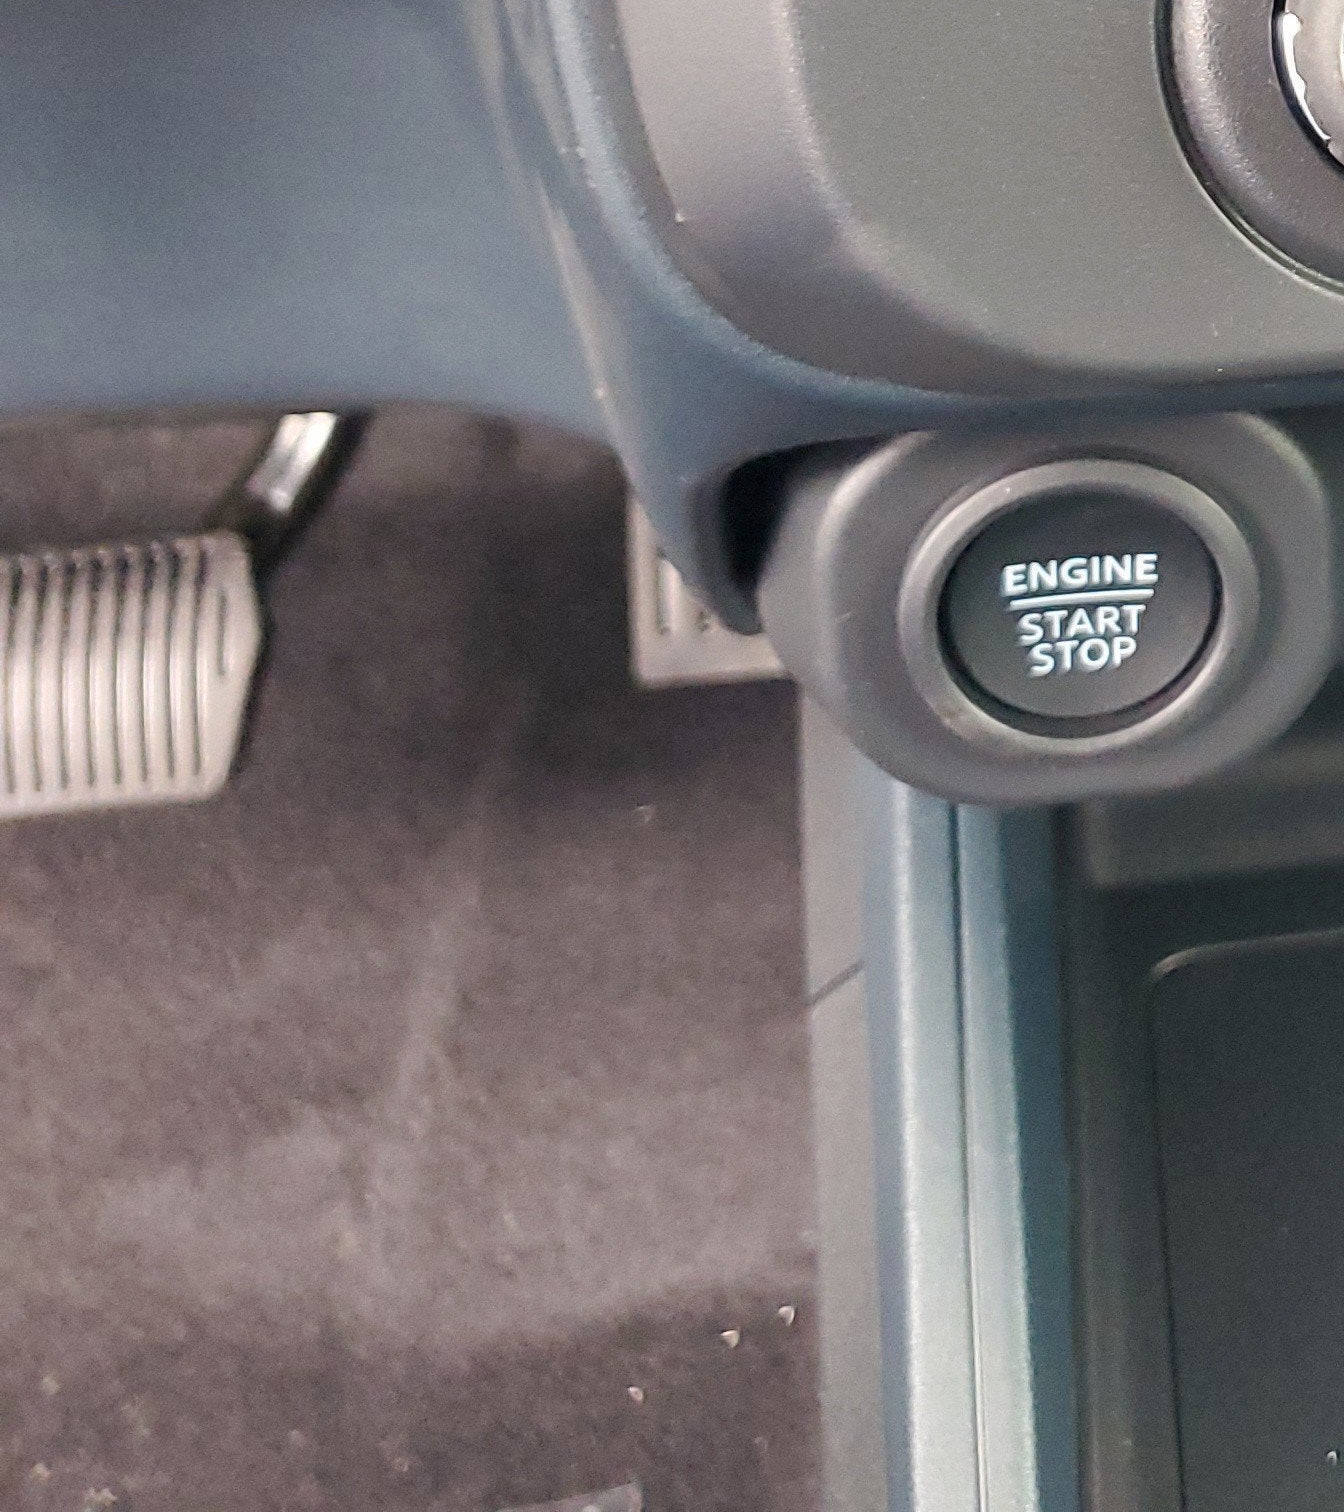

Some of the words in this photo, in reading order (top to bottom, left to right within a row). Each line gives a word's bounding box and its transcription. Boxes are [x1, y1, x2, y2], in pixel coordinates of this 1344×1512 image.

[1001, 553, 1158, 597] ENGINE
[1017, 604, 1146, 646] START
[1026, 636, 1137, 678] STOP
